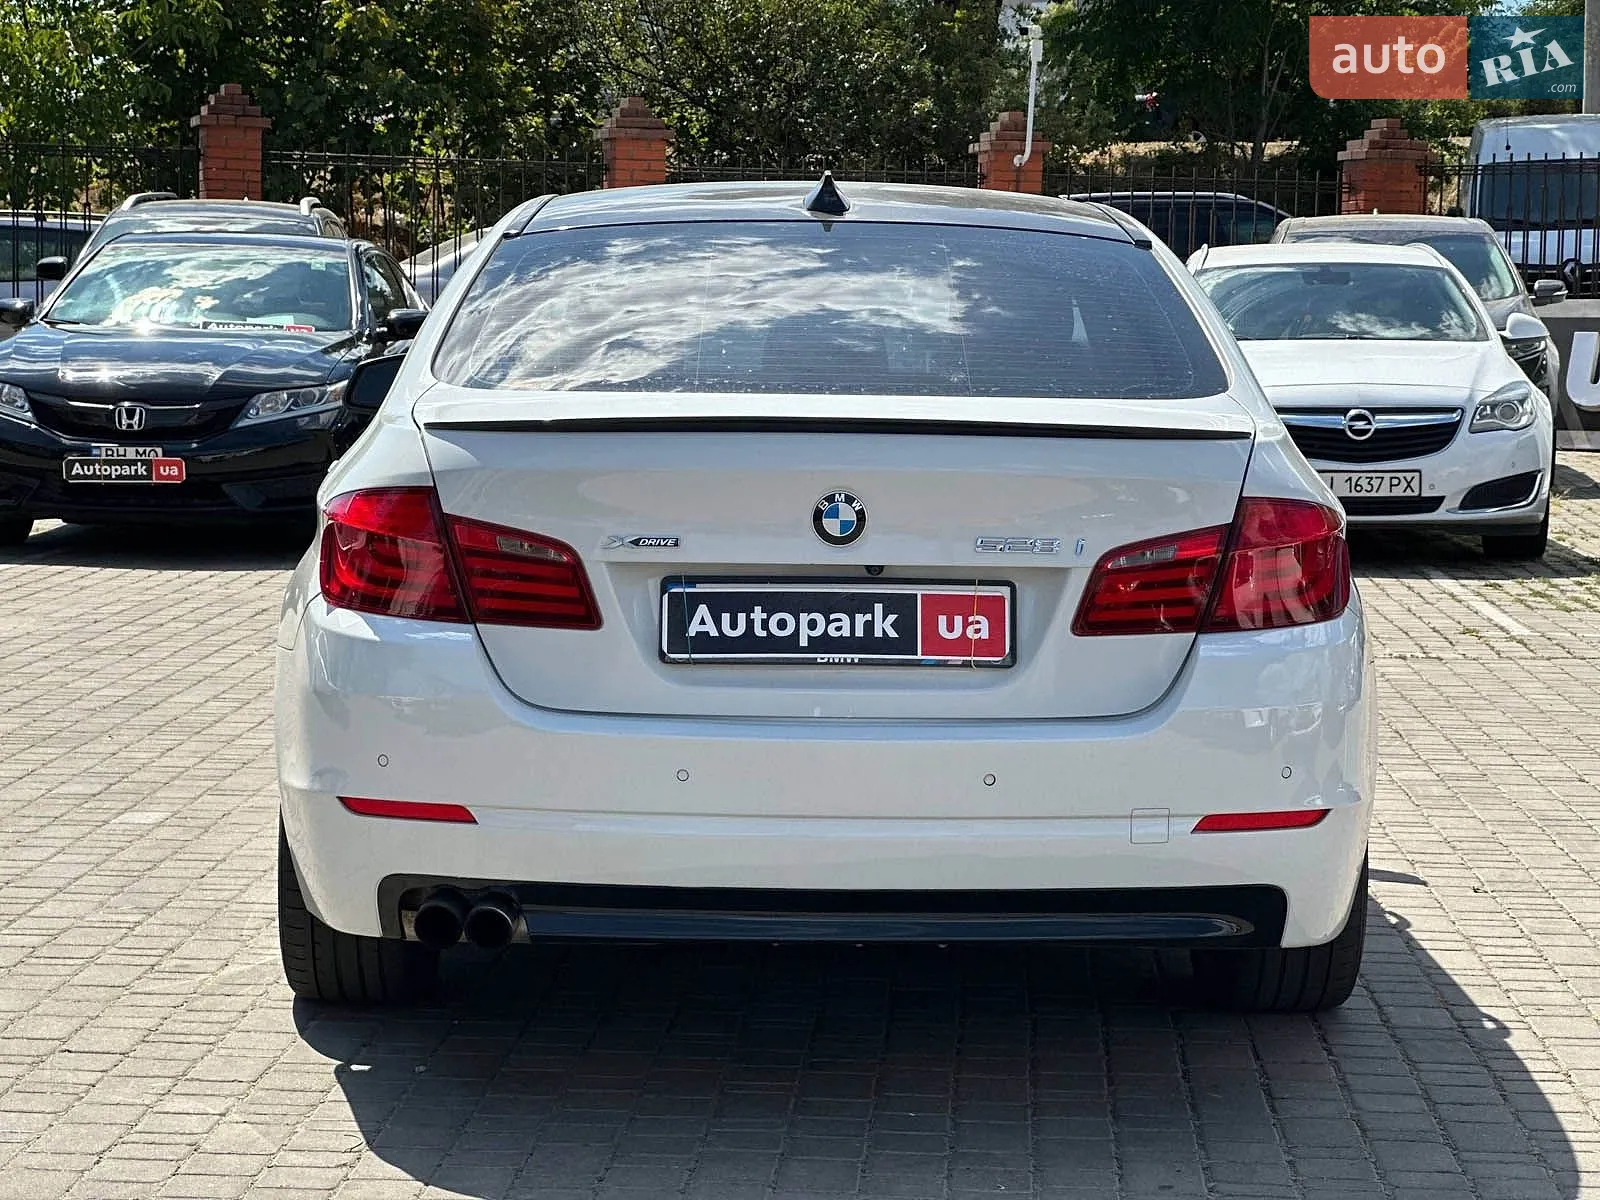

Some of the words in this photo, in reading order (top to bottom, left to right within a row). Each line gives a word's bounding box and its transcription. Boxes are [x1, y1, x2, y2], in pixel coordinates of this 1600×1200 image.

[71, 462, 148, 479] Autopark
[159, 466, 179, 476] ua
[1344, 475, 1385, 494] 1637
[1389, 475, 1416, 494] PX
[817, 493, 863, 511] BMW
[688, 603, 899, 647] Autopark
[937, 614, 990, 640] ua
